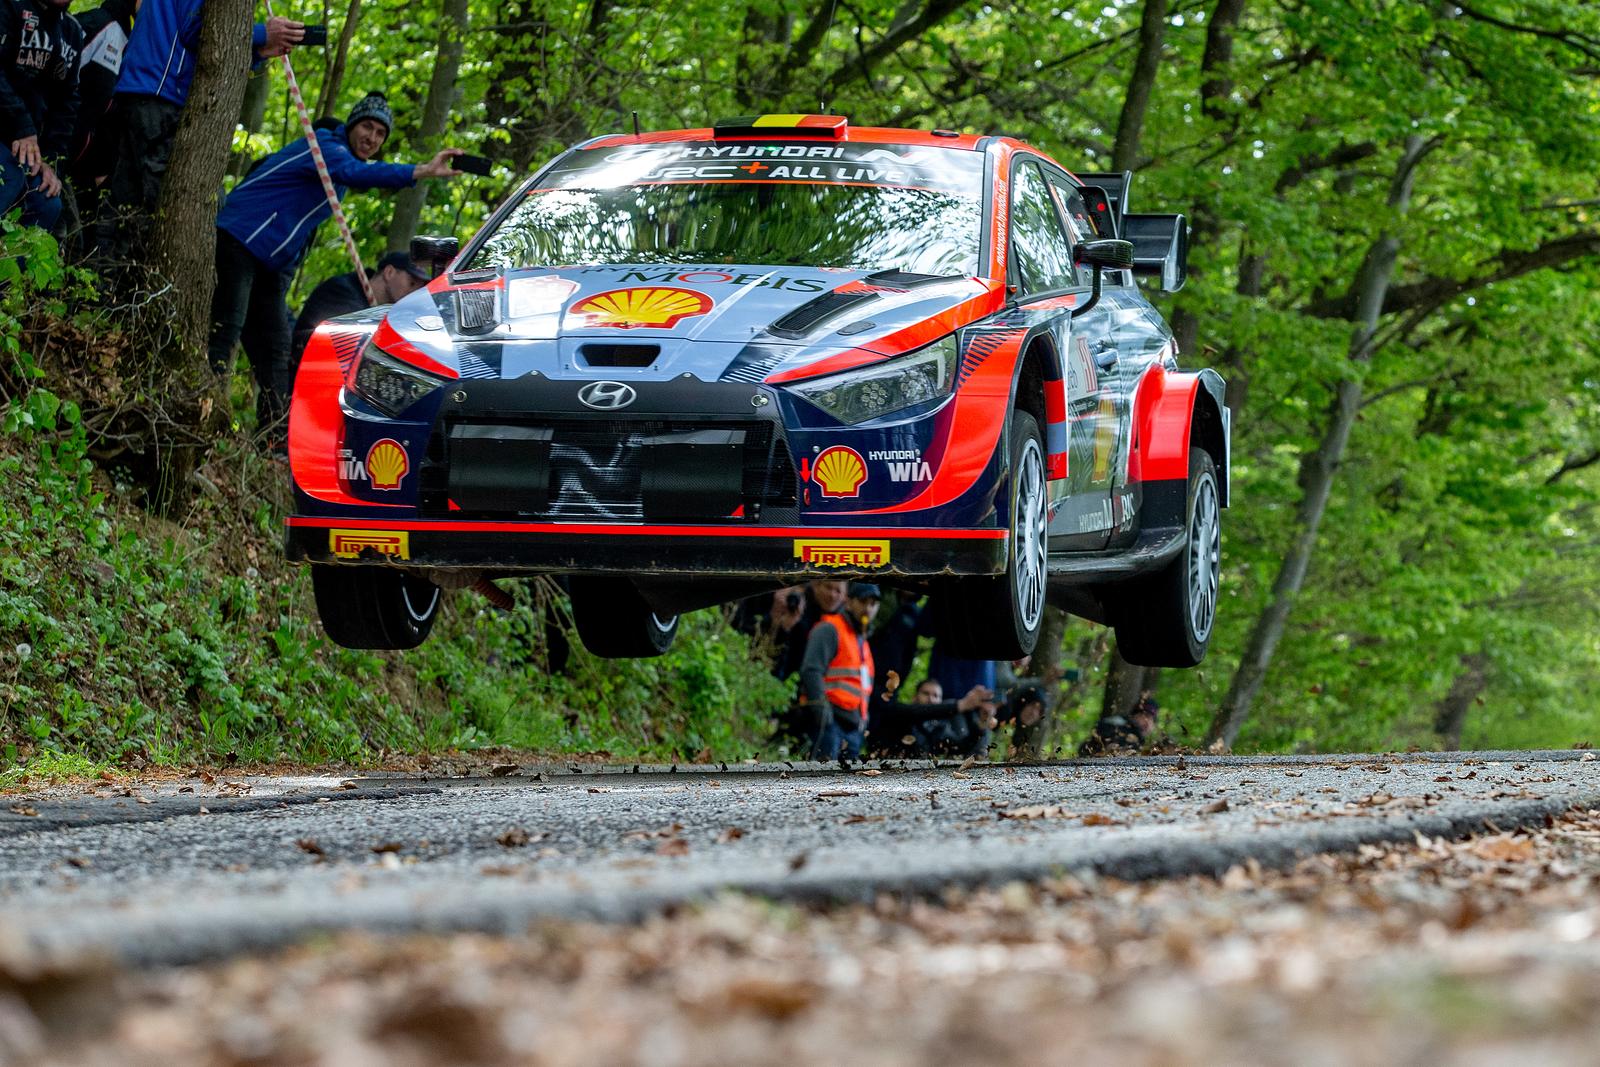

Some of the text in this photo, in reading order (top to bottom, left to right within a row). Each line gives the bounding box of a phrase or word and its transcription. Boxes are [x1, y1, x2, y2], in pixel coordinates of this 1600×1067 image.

[679, 145, 845, 159] HYUNDAI
[767, 166, 826, 179] ALL
[836, 167, 904, 182] LIVE
[617, 271, 826, 292] MOBIS
[868, 450, 915, 460] HYUNDAI
[887, 457, 933, 482] WIA
[802, 545, 882, 564] PIRELLI
